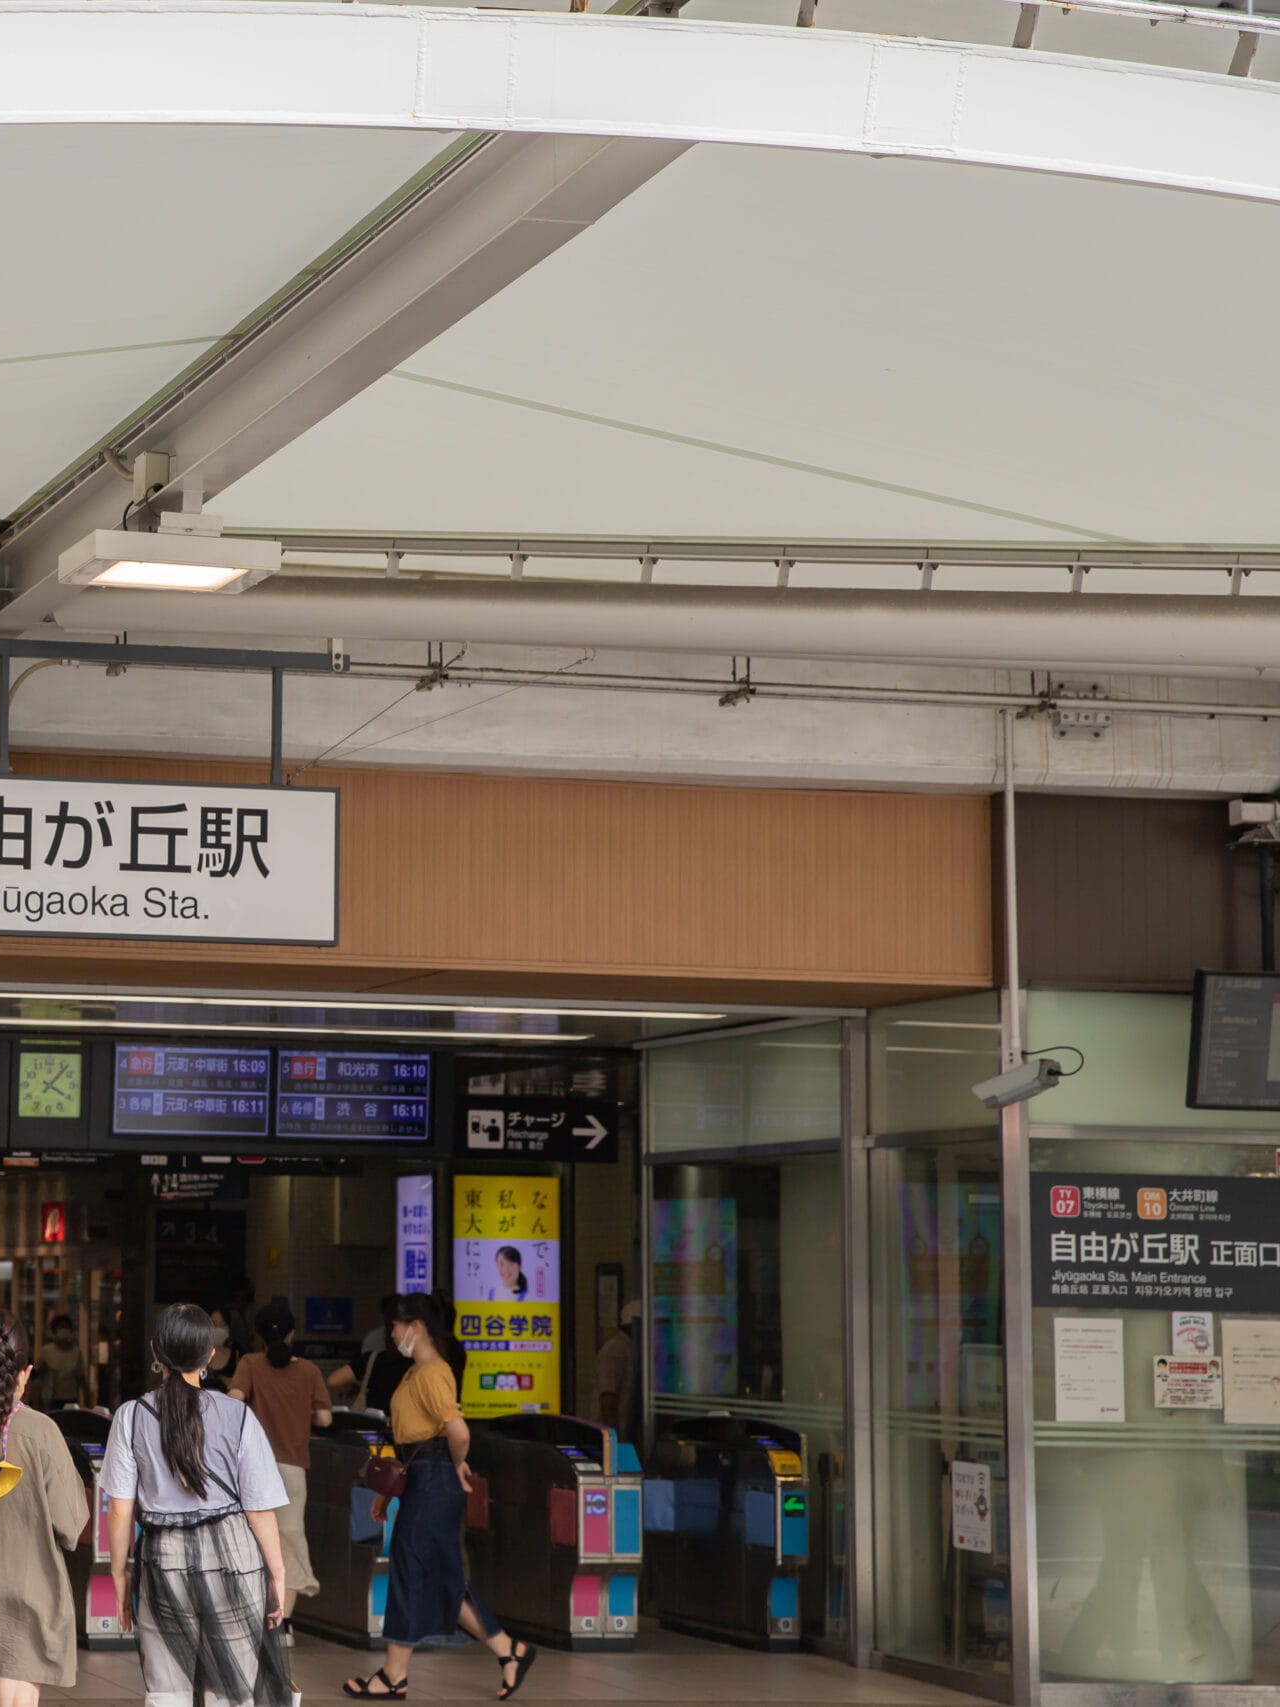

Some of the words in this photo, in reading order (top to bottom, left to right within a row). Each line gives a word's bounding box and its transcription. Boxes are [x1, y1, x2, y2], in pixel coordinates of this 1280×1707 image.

[143, 887, 209, 920] Sta.
[233, 1059, 267, 1073] 16:09
[337, 1061, 379, 1077] 和光市
[393, 1064, 426, 1078] 16:10
[231, 1099, 264, 1113] 16:11
[392, 1104, 424, 1118] 16:11
[507, 1111, 566, 1128] チャージ
[1058, 1189, 1073, 1199] TY
[1082, 1186, 1120, 1200] 東横線
[1143, 1191, 1160, 1201] OM
[1169, 1188, 1219, 1203] 大井町線
[497, 1189, 517, 1234] 私が
[1056, 1200, 1075, 1214] 07
[1143, 1202, 1162, 1217] 10
[1050, 1230, 1200, 1267] 自由が丘駅
[1209, 1240, 1280, 1268] 正面口
[1107, 1270, 1128, 1283] Sta.
[1131, 1271, 1158, 1283] Main
[1159, 1272, 1207, 1285] Entrance
[460, 1314, 553, 1337] 四谷学院
[101, 1619, 110, 1629] 6
[585, 1619, 593, 1628] 8
[615, 1618, 623, 1628] 9
